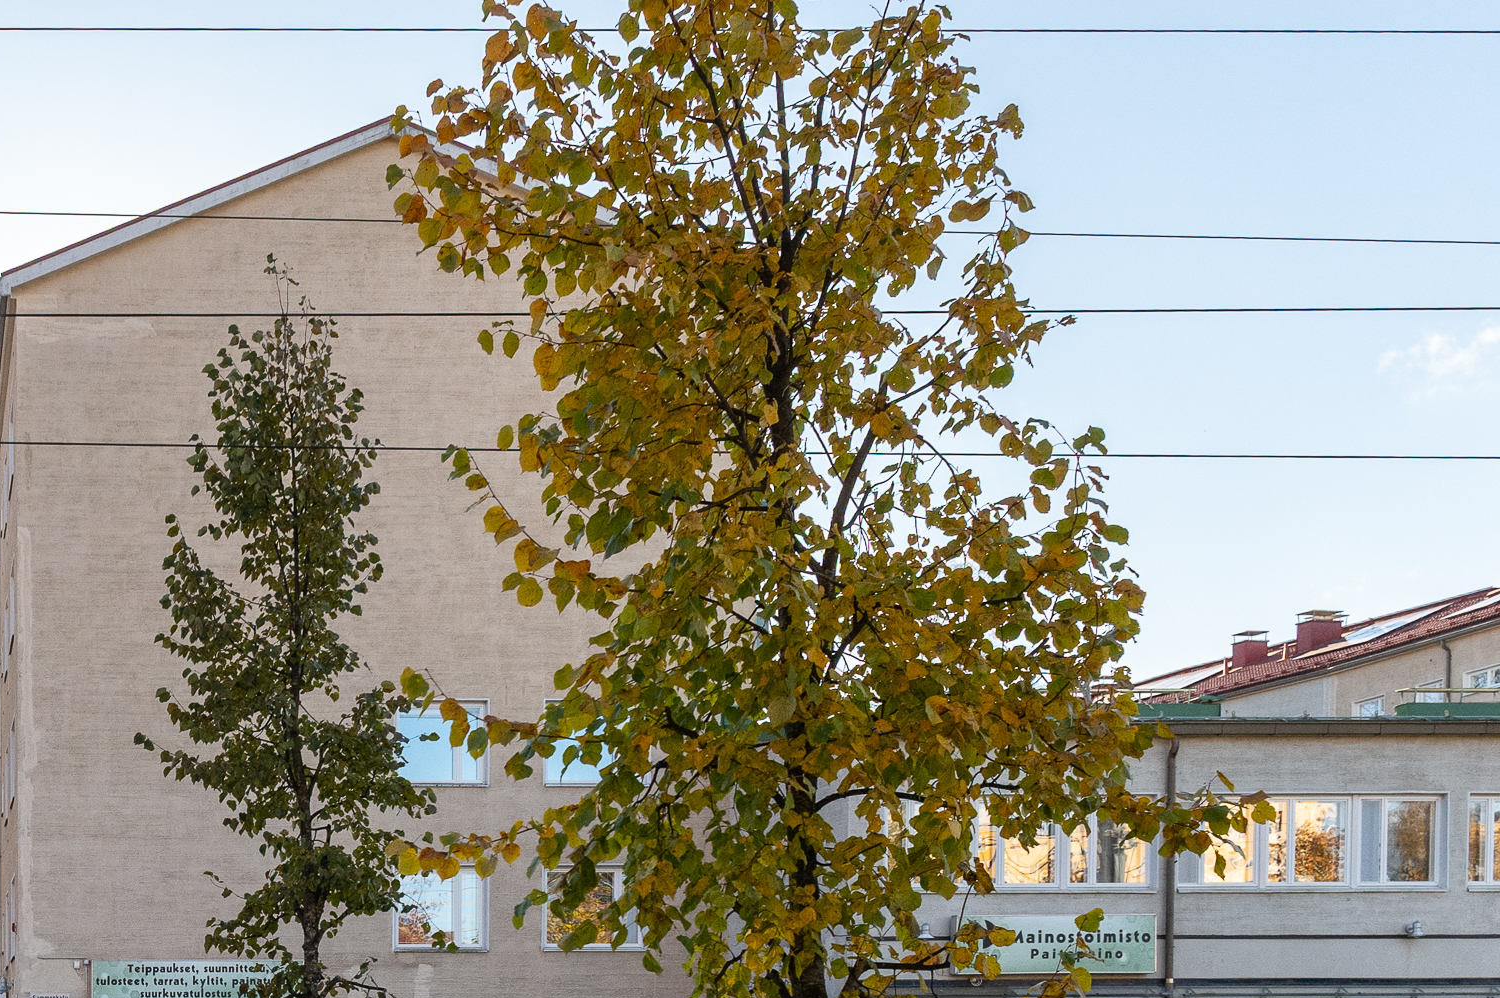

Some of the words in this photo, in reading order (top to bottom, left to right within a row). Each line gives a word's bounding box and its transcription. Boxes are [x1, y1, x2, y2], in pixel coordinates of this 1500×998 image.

[127, 963, 199, 976] Teippaukset,
[204, 964, 269, 975] suunnitteu,
[96, 976, 148, 987] tulosteet,
[154, 977, 188, 987] tarrat,
[192, 976, 227, 988] kyltit,
[140, 988, 231, 998] suurkuvatulostus
